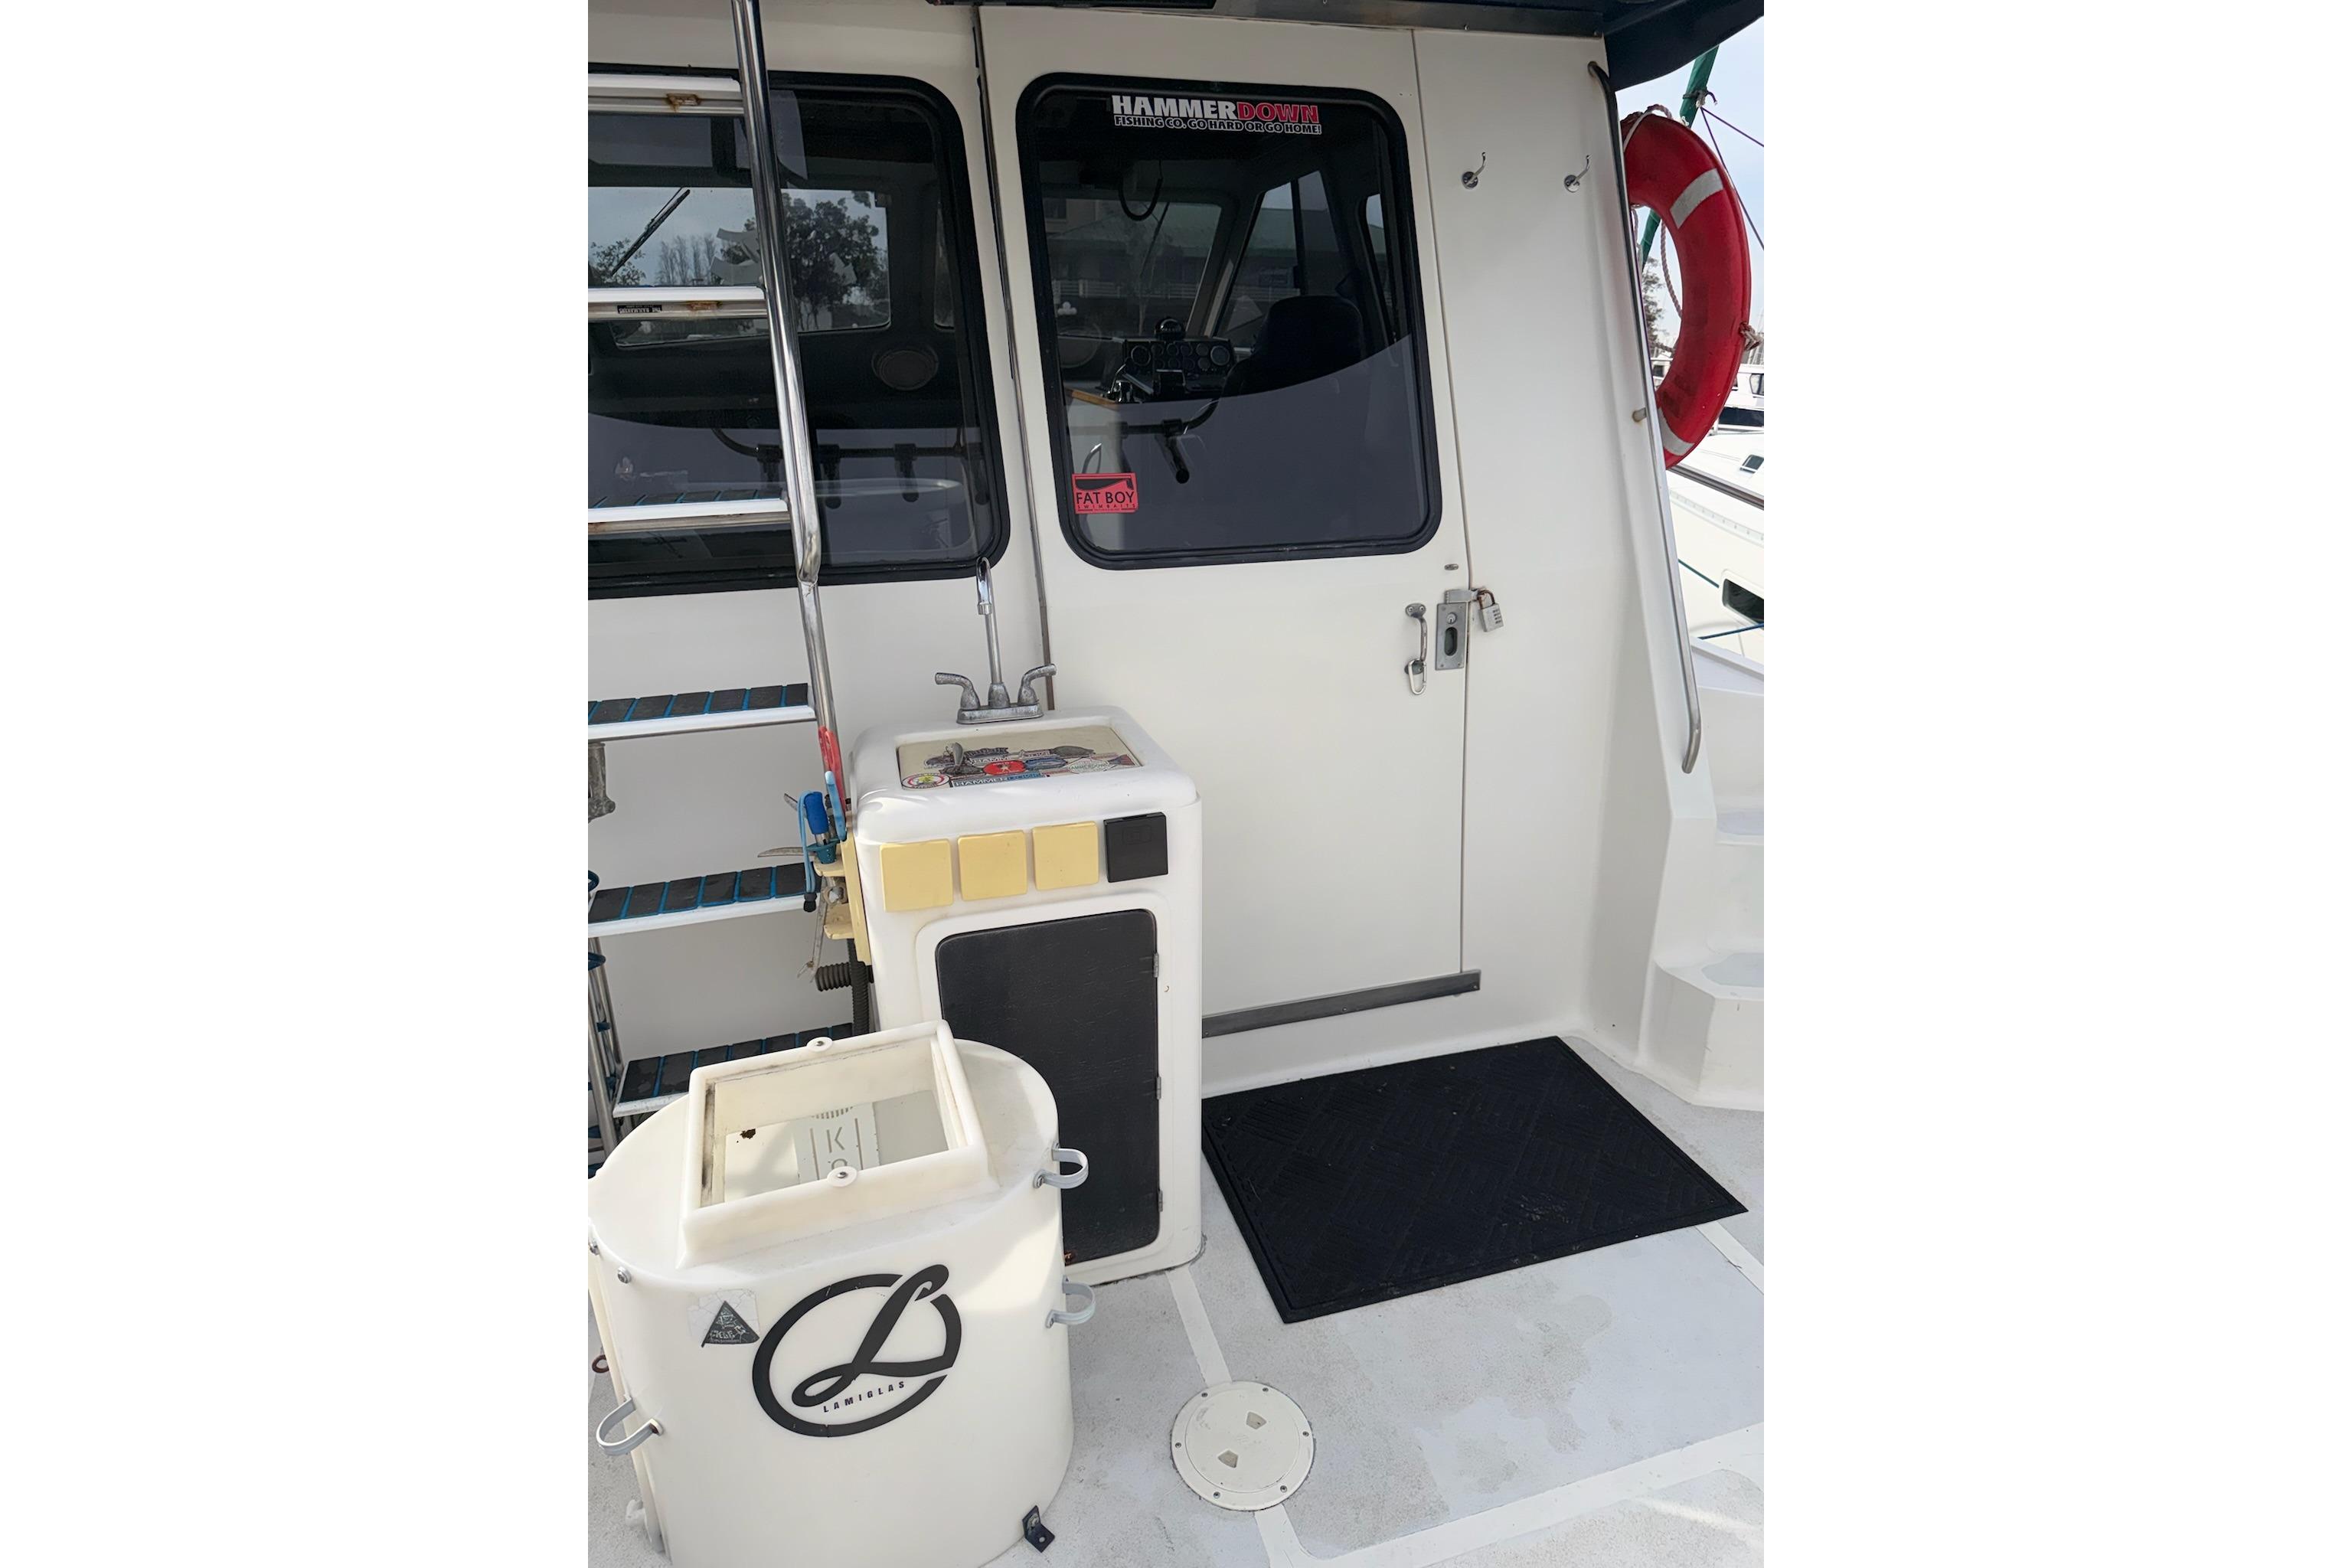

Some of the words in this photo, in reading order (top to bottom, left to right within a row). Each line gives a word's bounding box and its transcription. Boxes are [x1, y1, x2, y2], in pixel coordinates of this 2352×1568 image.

[1112, 95, 1319, 123] HAMMERDOWN
[1114, 115, 1164, 127] FISHING
[1165, 117, 1187, 129] CO.
[1187, 119, 1207, 130] GO
[1208, 119, 1244, 131] HARD
[1244, 121, 1265, 132] OR
[1265, 122, 1284, 132] GO
[1284, 122, 1322, 135] HOME!
[1076, 492, 1101, 505] FAT
[1106, 491, 1135, 504] BOY
[823, 1380, 905, 1413] LAMIGLAS
